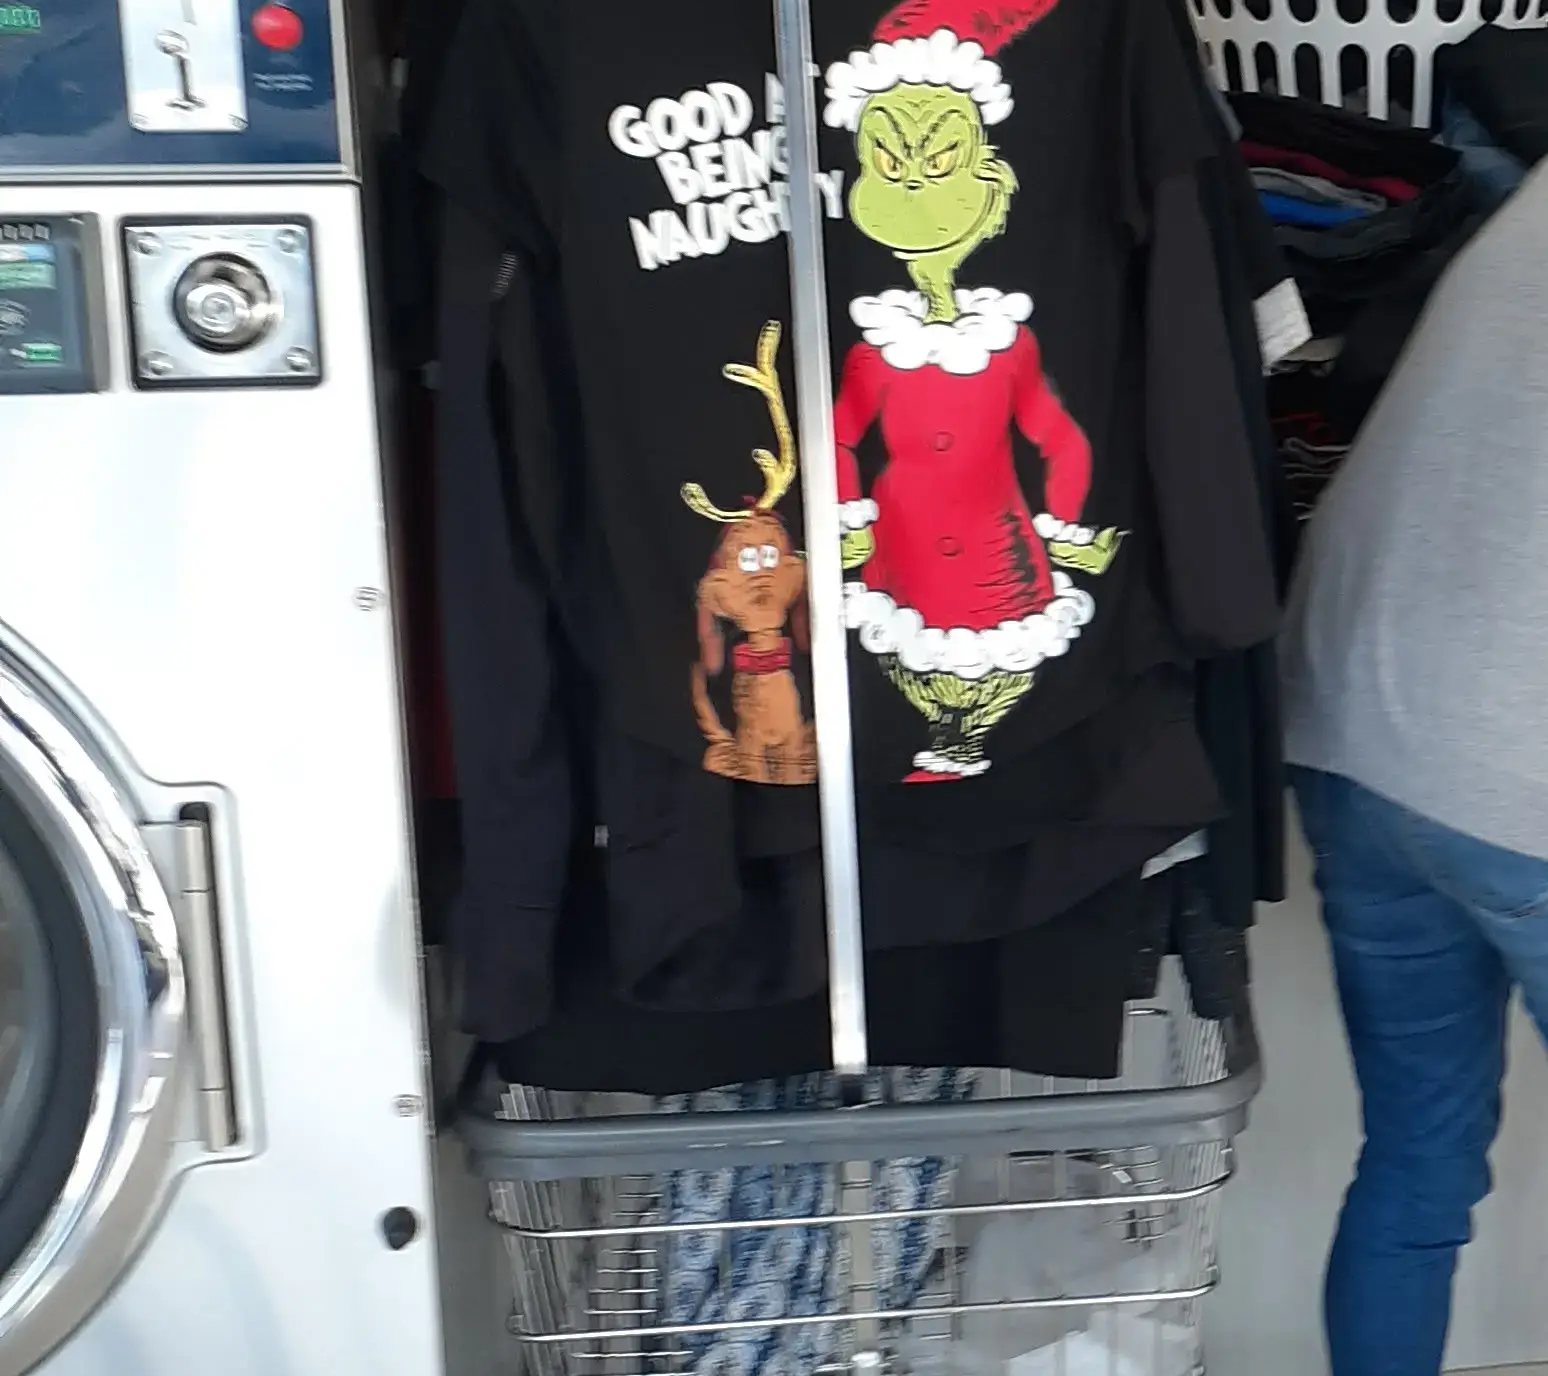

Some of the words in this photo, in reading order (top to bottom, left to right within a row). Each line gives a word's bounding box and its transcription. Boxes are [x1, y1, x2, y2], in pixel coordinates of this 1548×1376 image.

[608, 82, 753, 158] GOOD
[656, 126, 791, 205] BEING
[628, 170, 845, 271] NAUGHY
